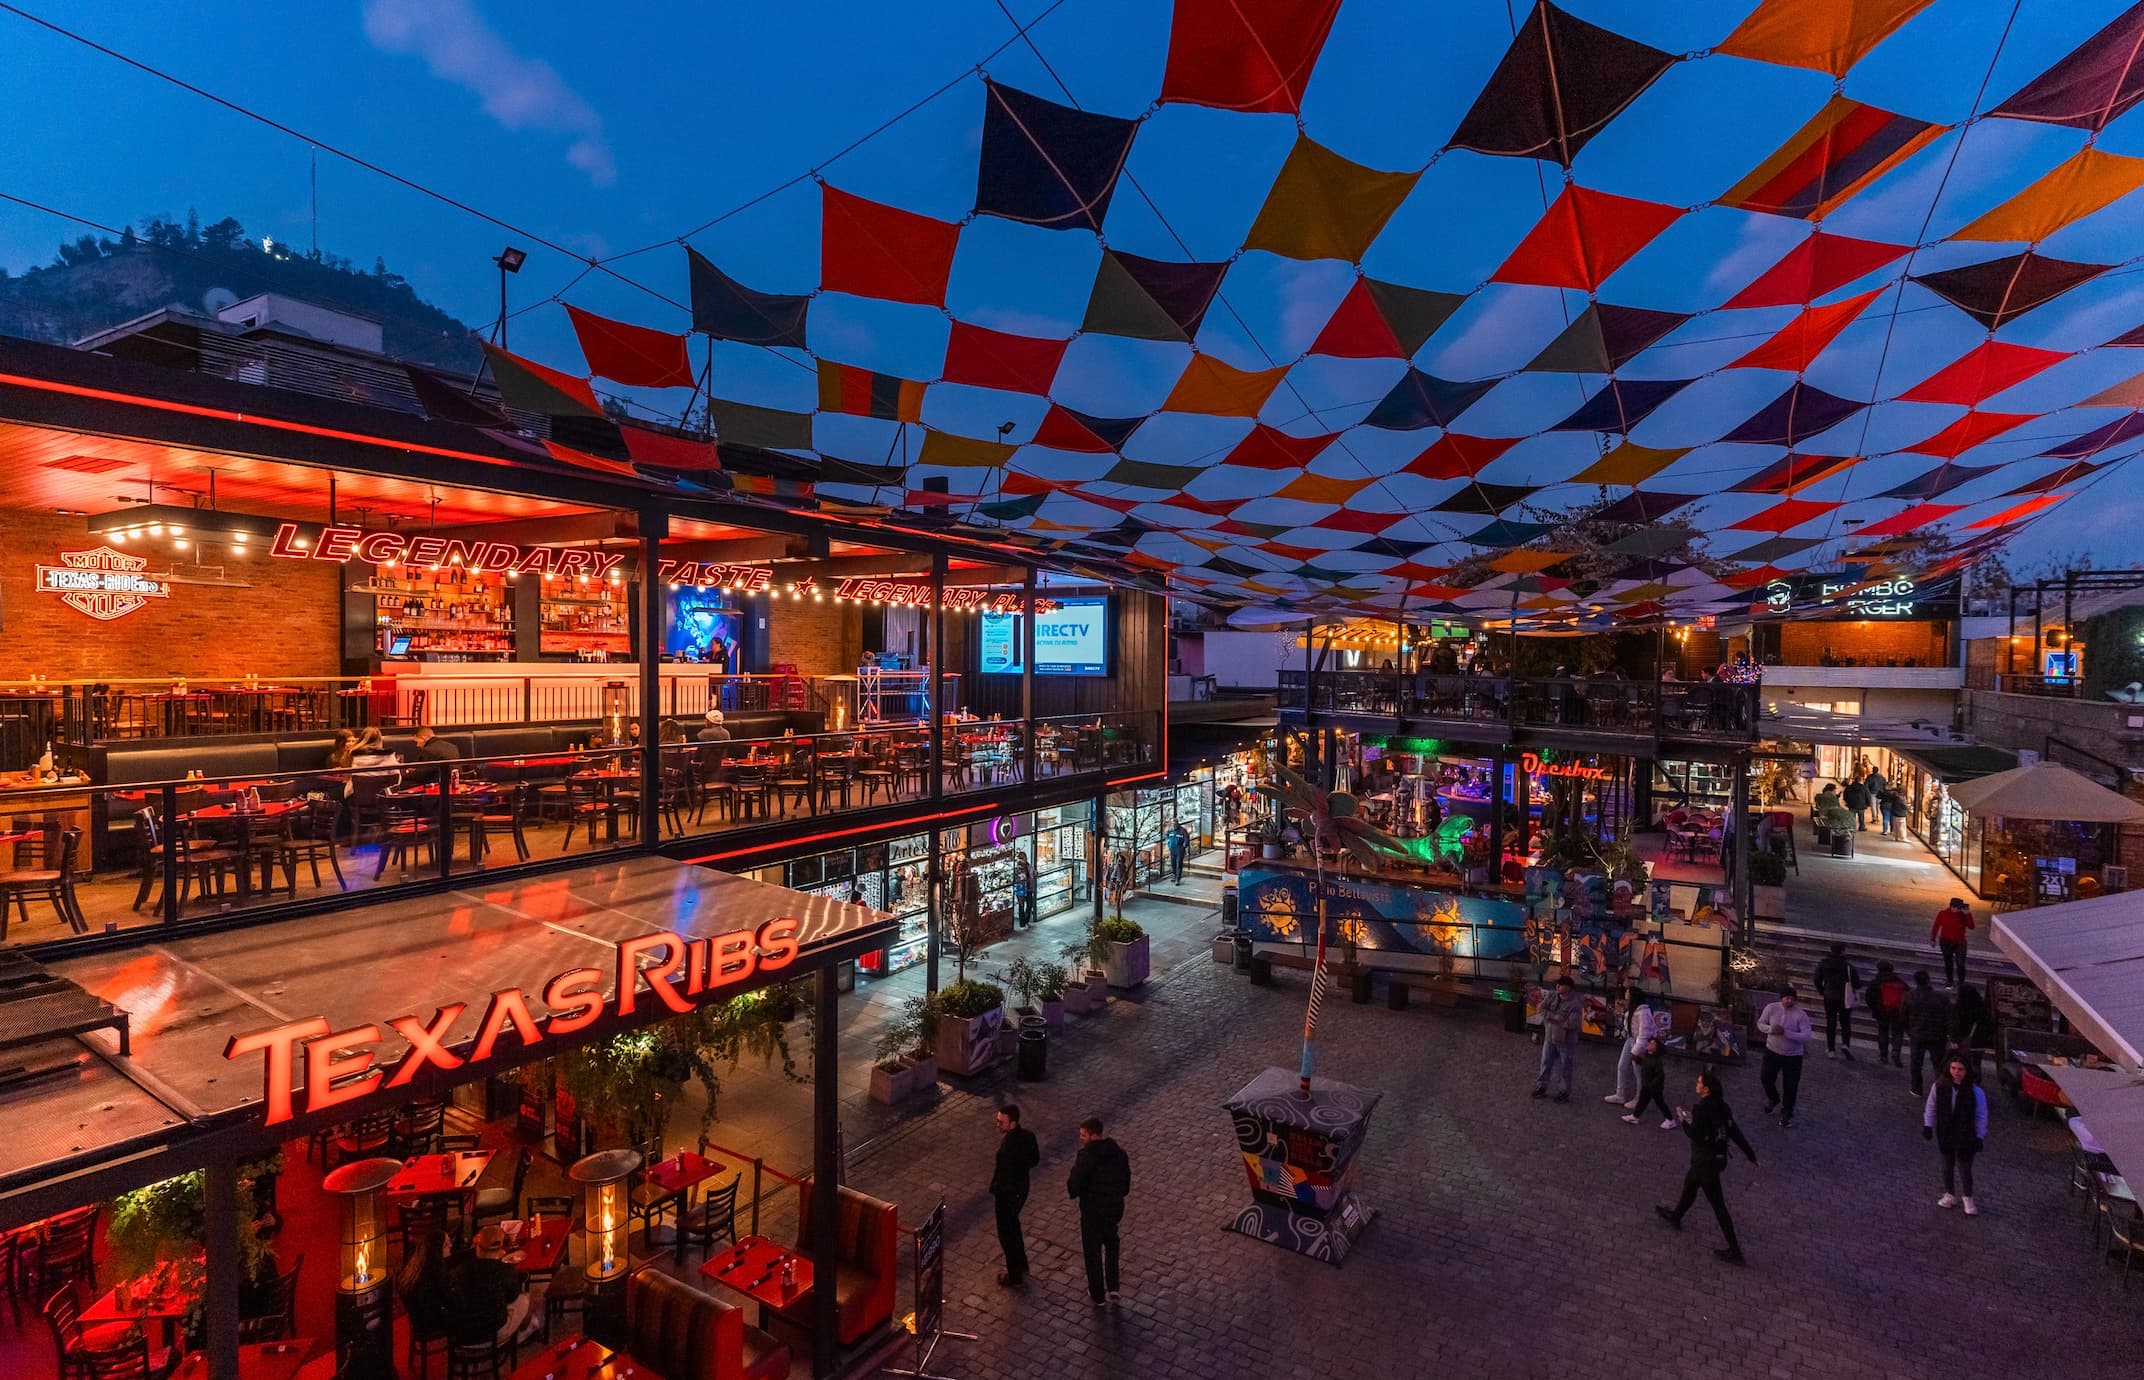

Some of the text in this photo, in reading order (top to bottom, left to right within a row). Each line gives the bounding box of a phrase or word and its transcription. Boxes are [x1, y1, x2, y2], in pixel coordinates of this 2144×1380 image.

[72, 553, 138, 571] MOTOR
[271, 523, 626, 579] LEGENDARY
[657, 559, 774, 592] TASTE
[72, 592, 136, 615] CYCLES
[1522, 752, 1605, 780] Openbox
[222, 917, 801, 1127] TEXAS RIBS
